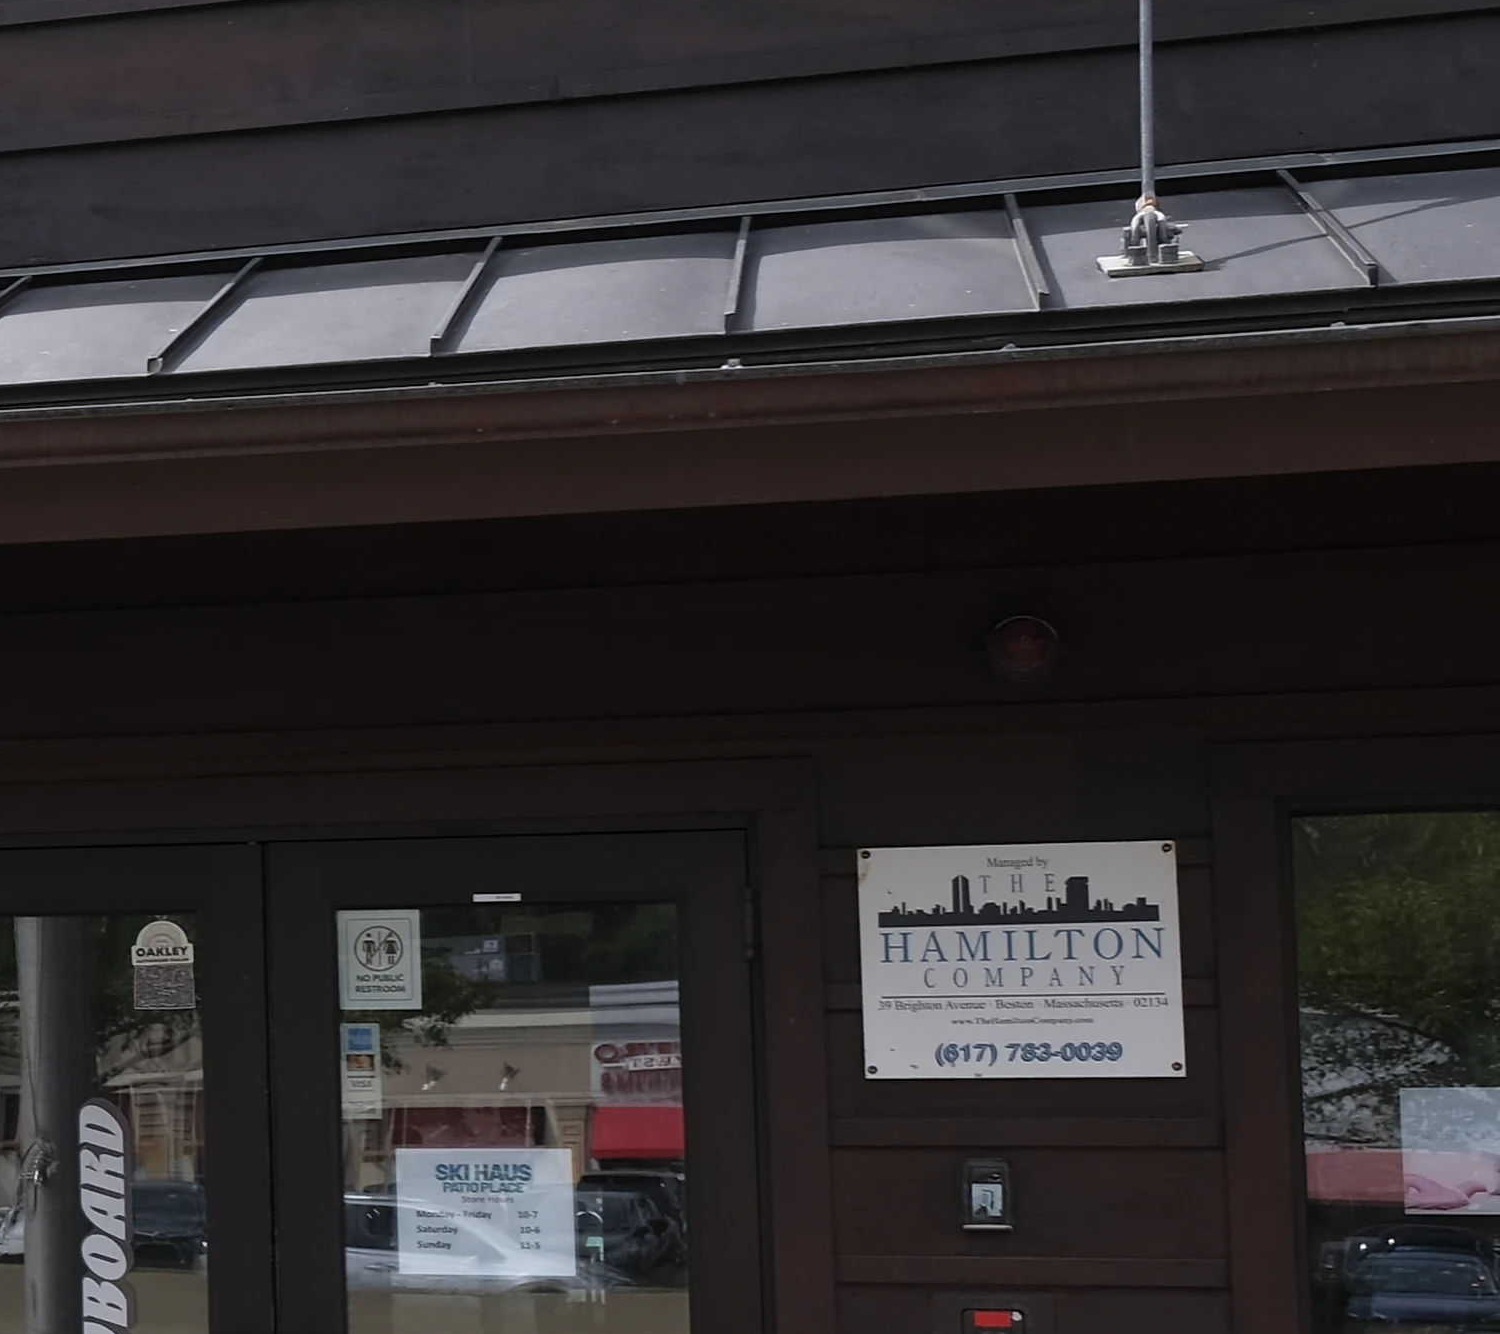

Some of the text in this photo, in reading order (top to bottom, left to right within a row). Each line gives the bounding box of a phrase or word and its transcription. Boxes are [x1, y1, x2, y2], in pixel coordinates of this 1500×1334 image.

[986, 856, 1049, 870] Managed by
[978, 873, 1057, 894] THE
[879, 926, 1167, 964] HAMILTON
[135, 946, 188, 957] OAKLEY
[356, 973, 405, 983] NO PUBLIC
[923, 964, 1126, 989] COMPANY
[355, 984, 406, 993] RESTROOM
[877, 997, 1169, 1013] 39 Brighton Avenue Boston Massachusetts 02134
[934, 1040, 1124, 1067] (617) 783-0039
[435, 1163, 532, 1181] SKI HAUS
[442, 1182, 525, 1193] PATIO PLACE
[461, 1195, 515, 1204] Store Hours
[416, 1210, 455, 1220] Monday
[463, 1210, 492, 1221] Friday
[517, 1210, 539, 1219] 10-7
[416, 1225, 458, 1236] Saturday
[416, 1240, 452, 1251] Sunday
